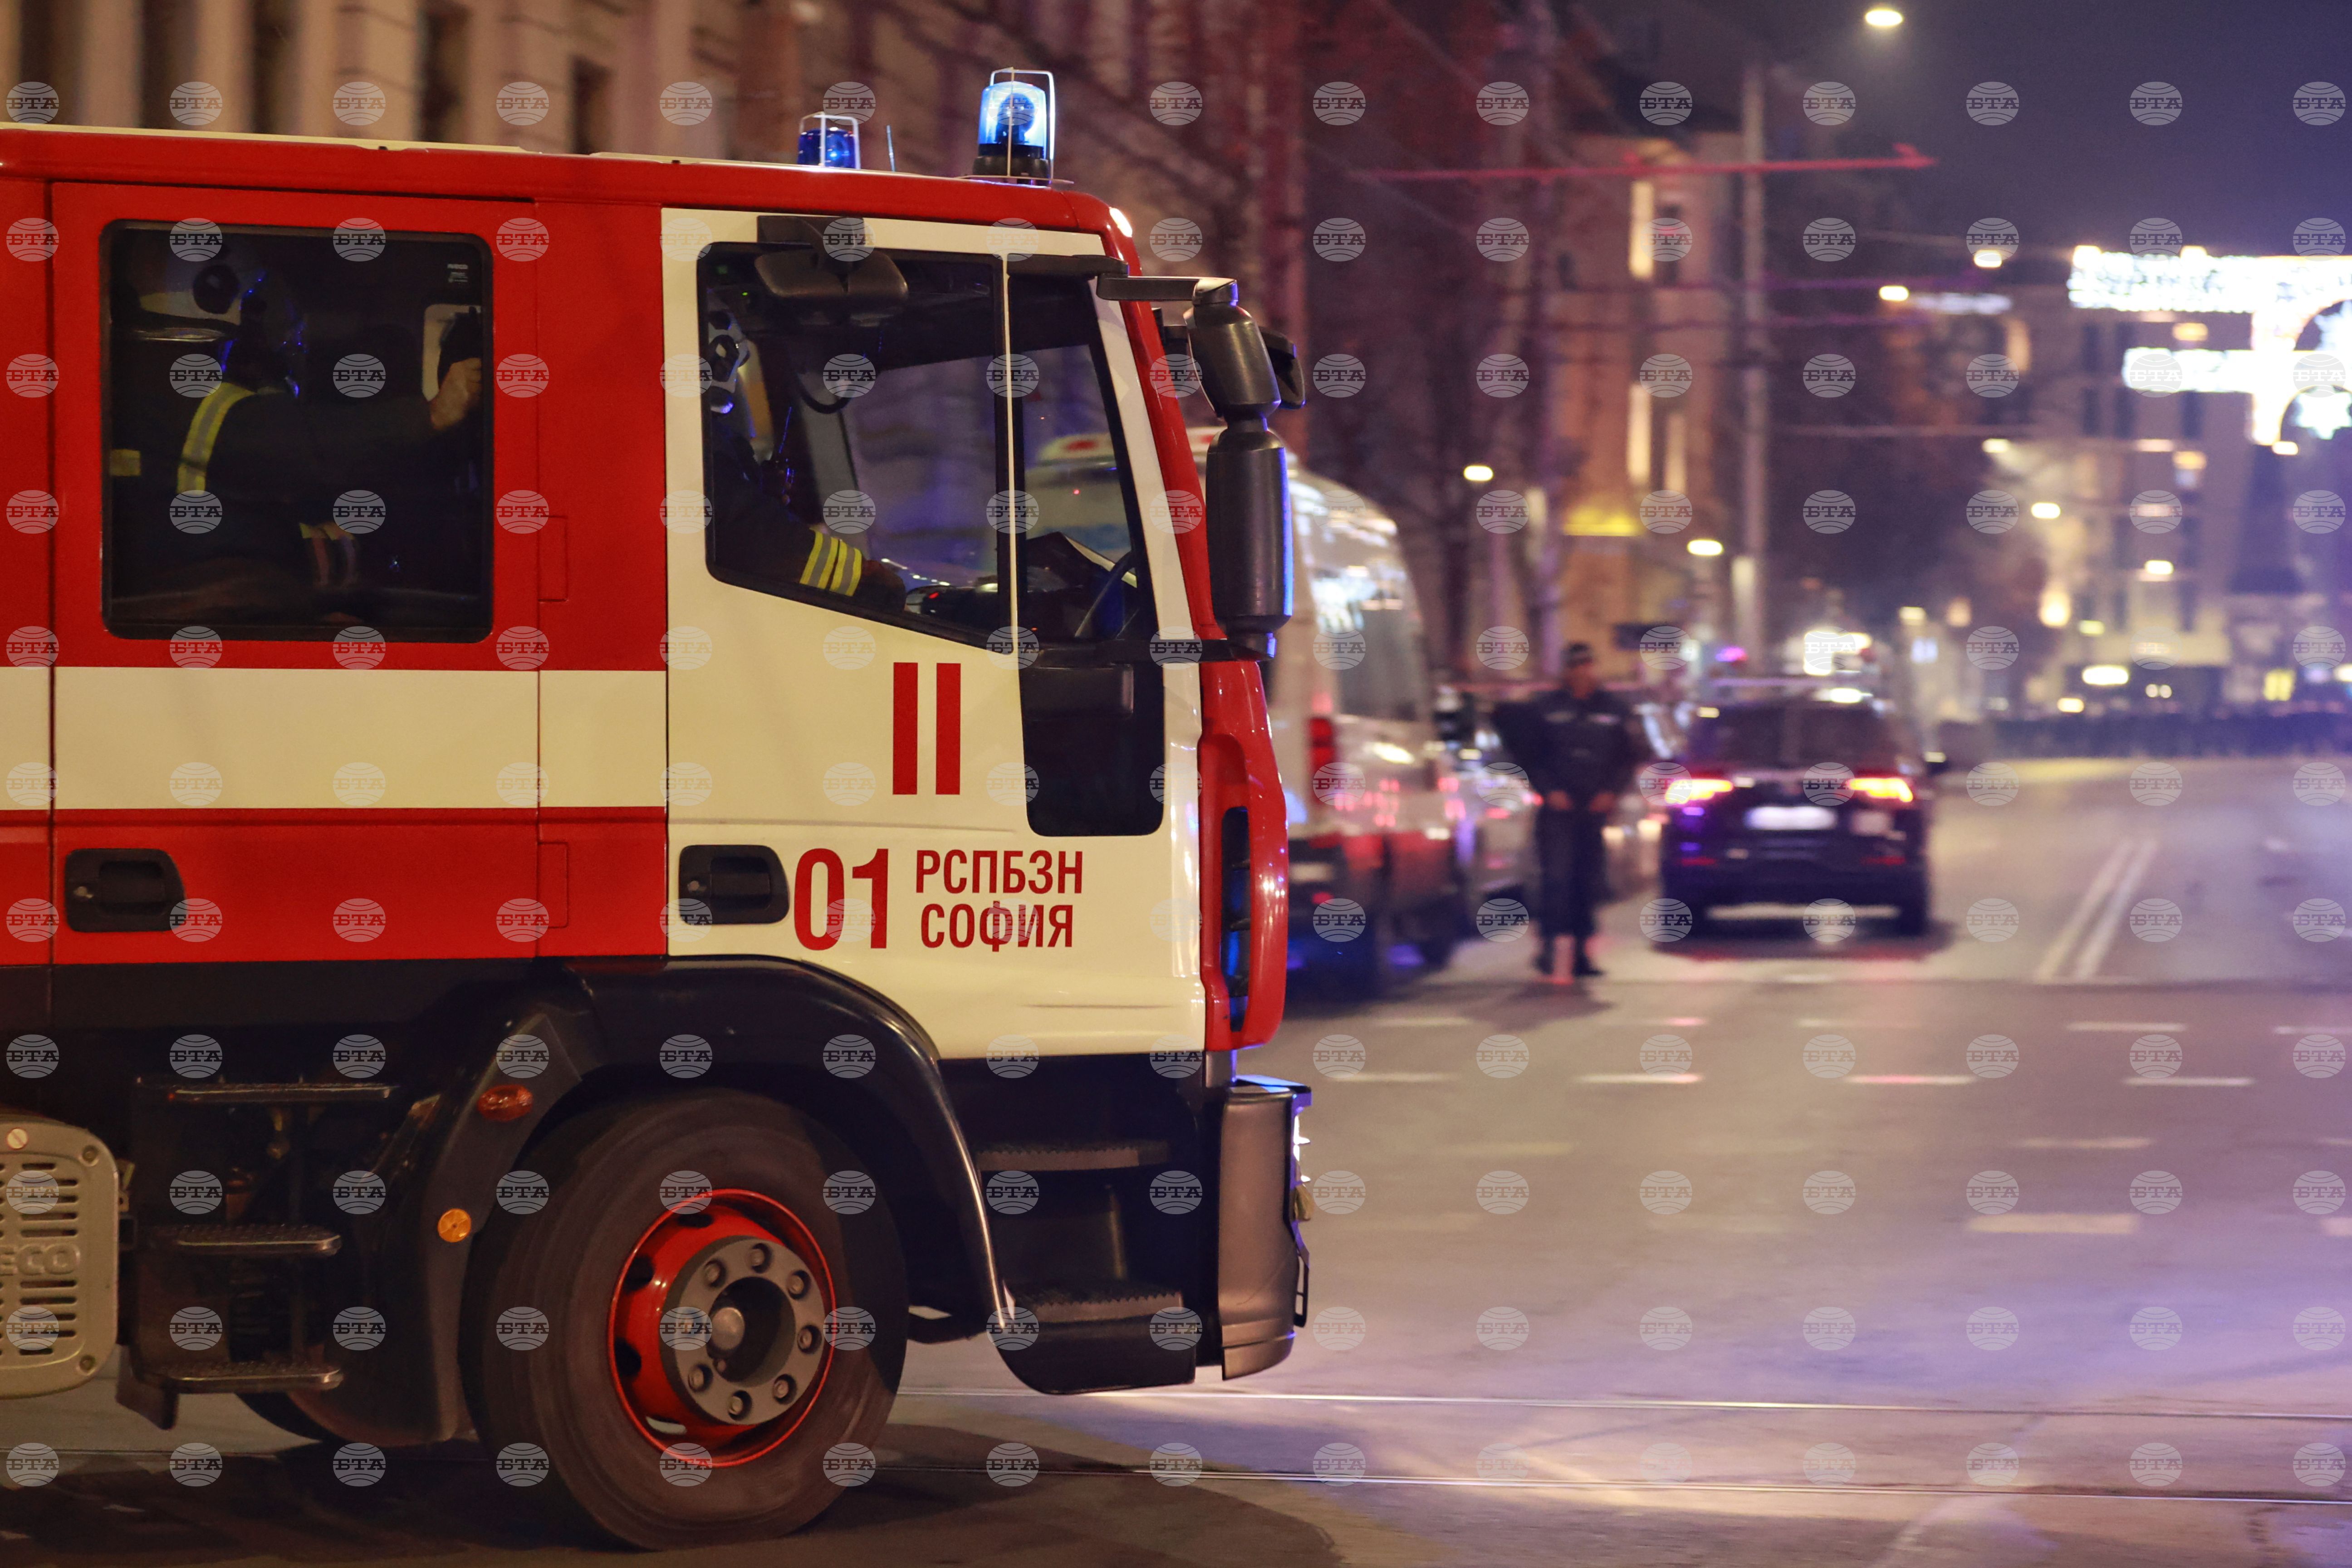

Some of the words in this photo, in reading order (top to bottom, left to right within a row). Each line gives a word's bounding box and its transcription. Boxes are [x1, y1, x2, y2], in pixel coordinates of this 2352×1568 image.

[916, 849, 1083, 894] РСПБЗН
[794, 848, 888, 950] 01
[921, 902, 1073, 951] СОФИЯ
